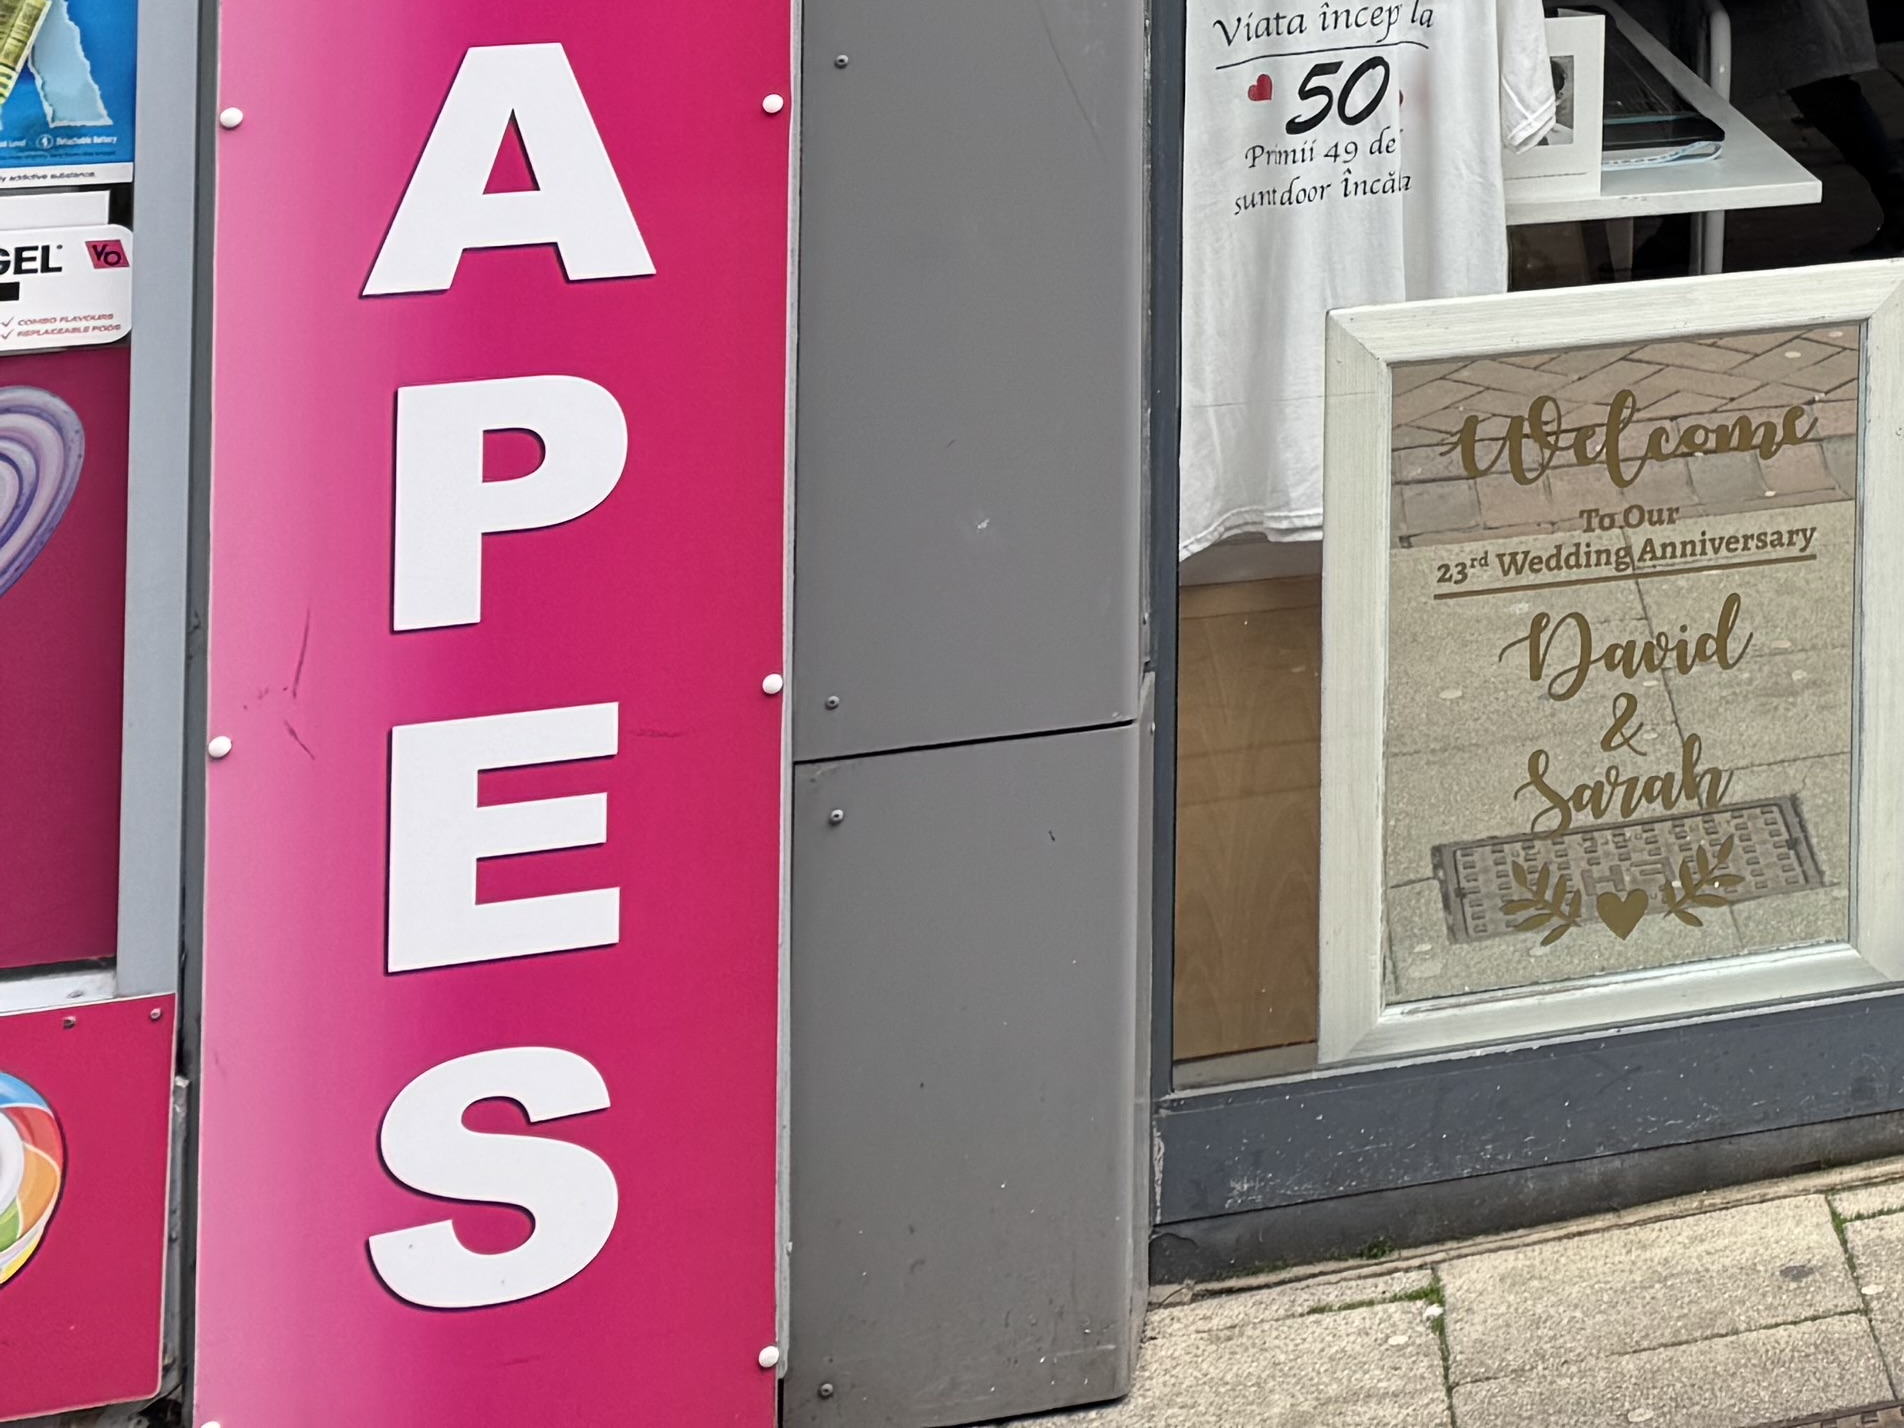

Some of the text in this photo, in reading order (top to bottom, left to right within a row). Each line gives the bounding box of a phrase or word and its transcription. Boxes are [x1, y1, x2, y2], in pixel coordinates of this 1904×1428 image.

[1285, 55, 1391, 135] 50
[1323, 141, 1359, 164] 49
[1441, 389, 1818, 488] Welcome
[1579, 503, 1680, 533] To Our
[1436, 525, 1817, 586] 23rd Wedding Anniversary
[1499, 592, 1754, 702] David
[1600, 692, 1647, 757] &
[1513, 734, 1735, 839] Sarah
